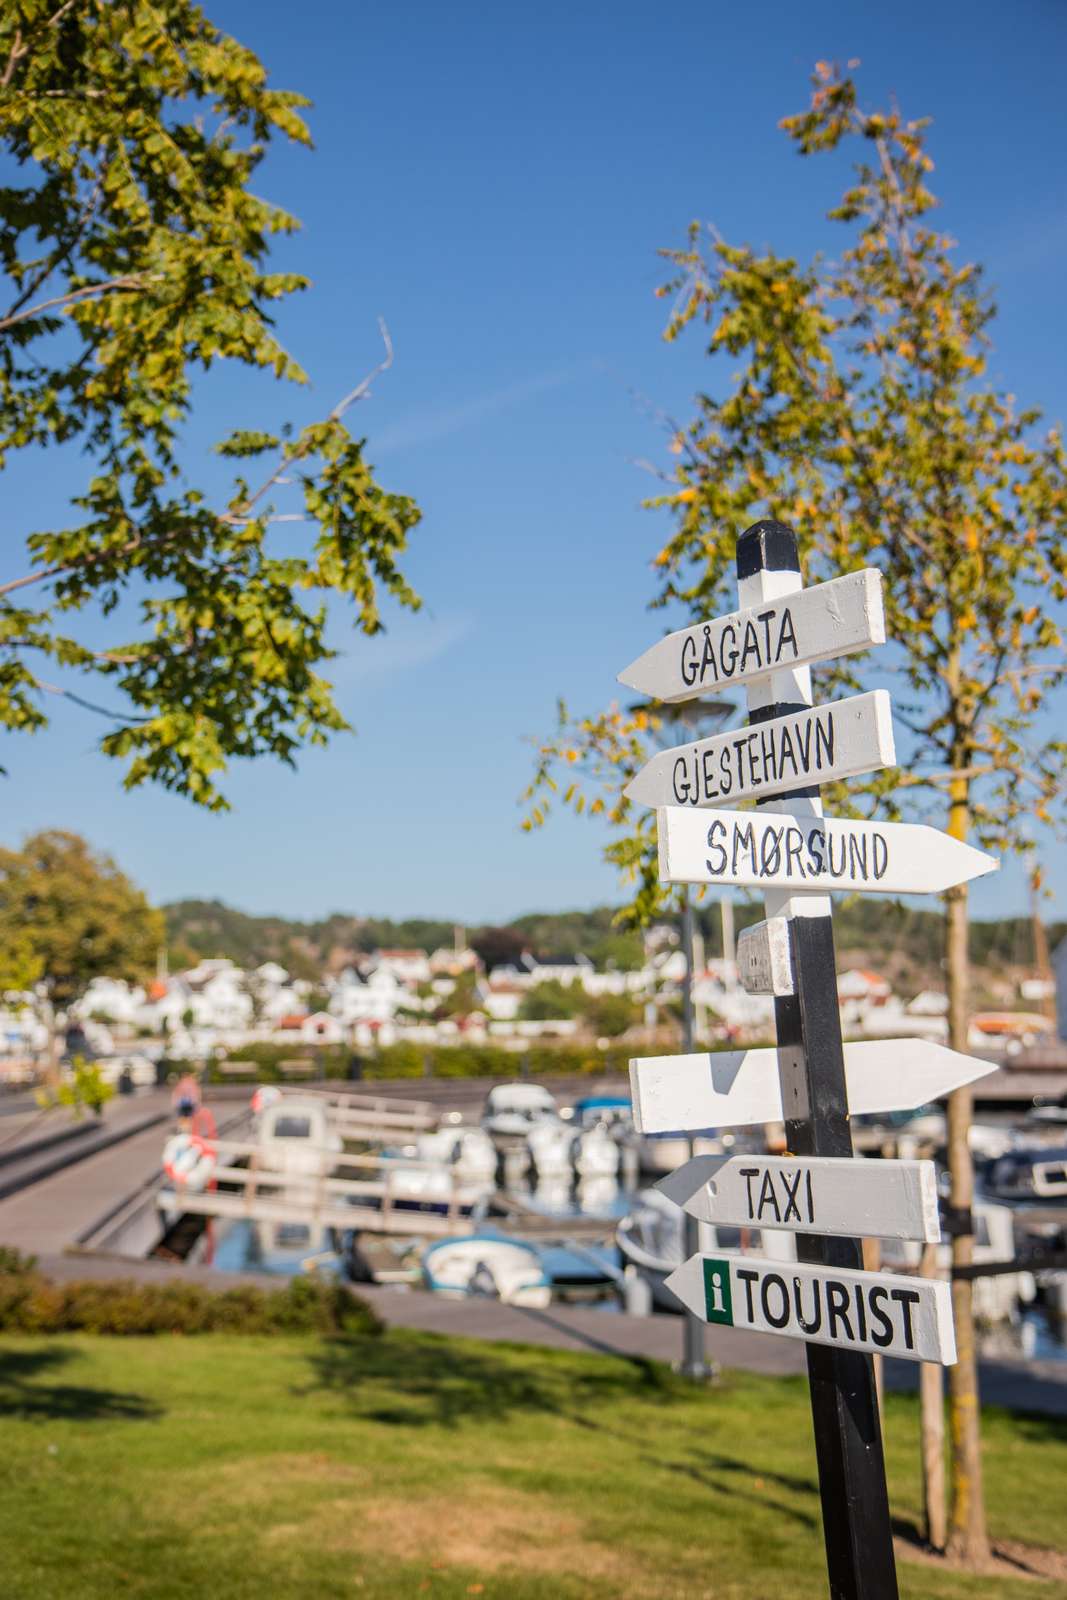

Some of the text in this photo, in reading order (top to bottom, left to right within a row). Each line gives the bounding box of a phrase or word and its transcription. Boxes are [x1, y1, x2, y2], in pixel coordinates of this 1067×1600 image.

[681, 608, 798, 686] GÅGATA
[706, 820, 888, 880] SMØRSUND
[739, 1168, 814, 1223] TAXI
[736, 1269, 920, 1349] TOURIST
